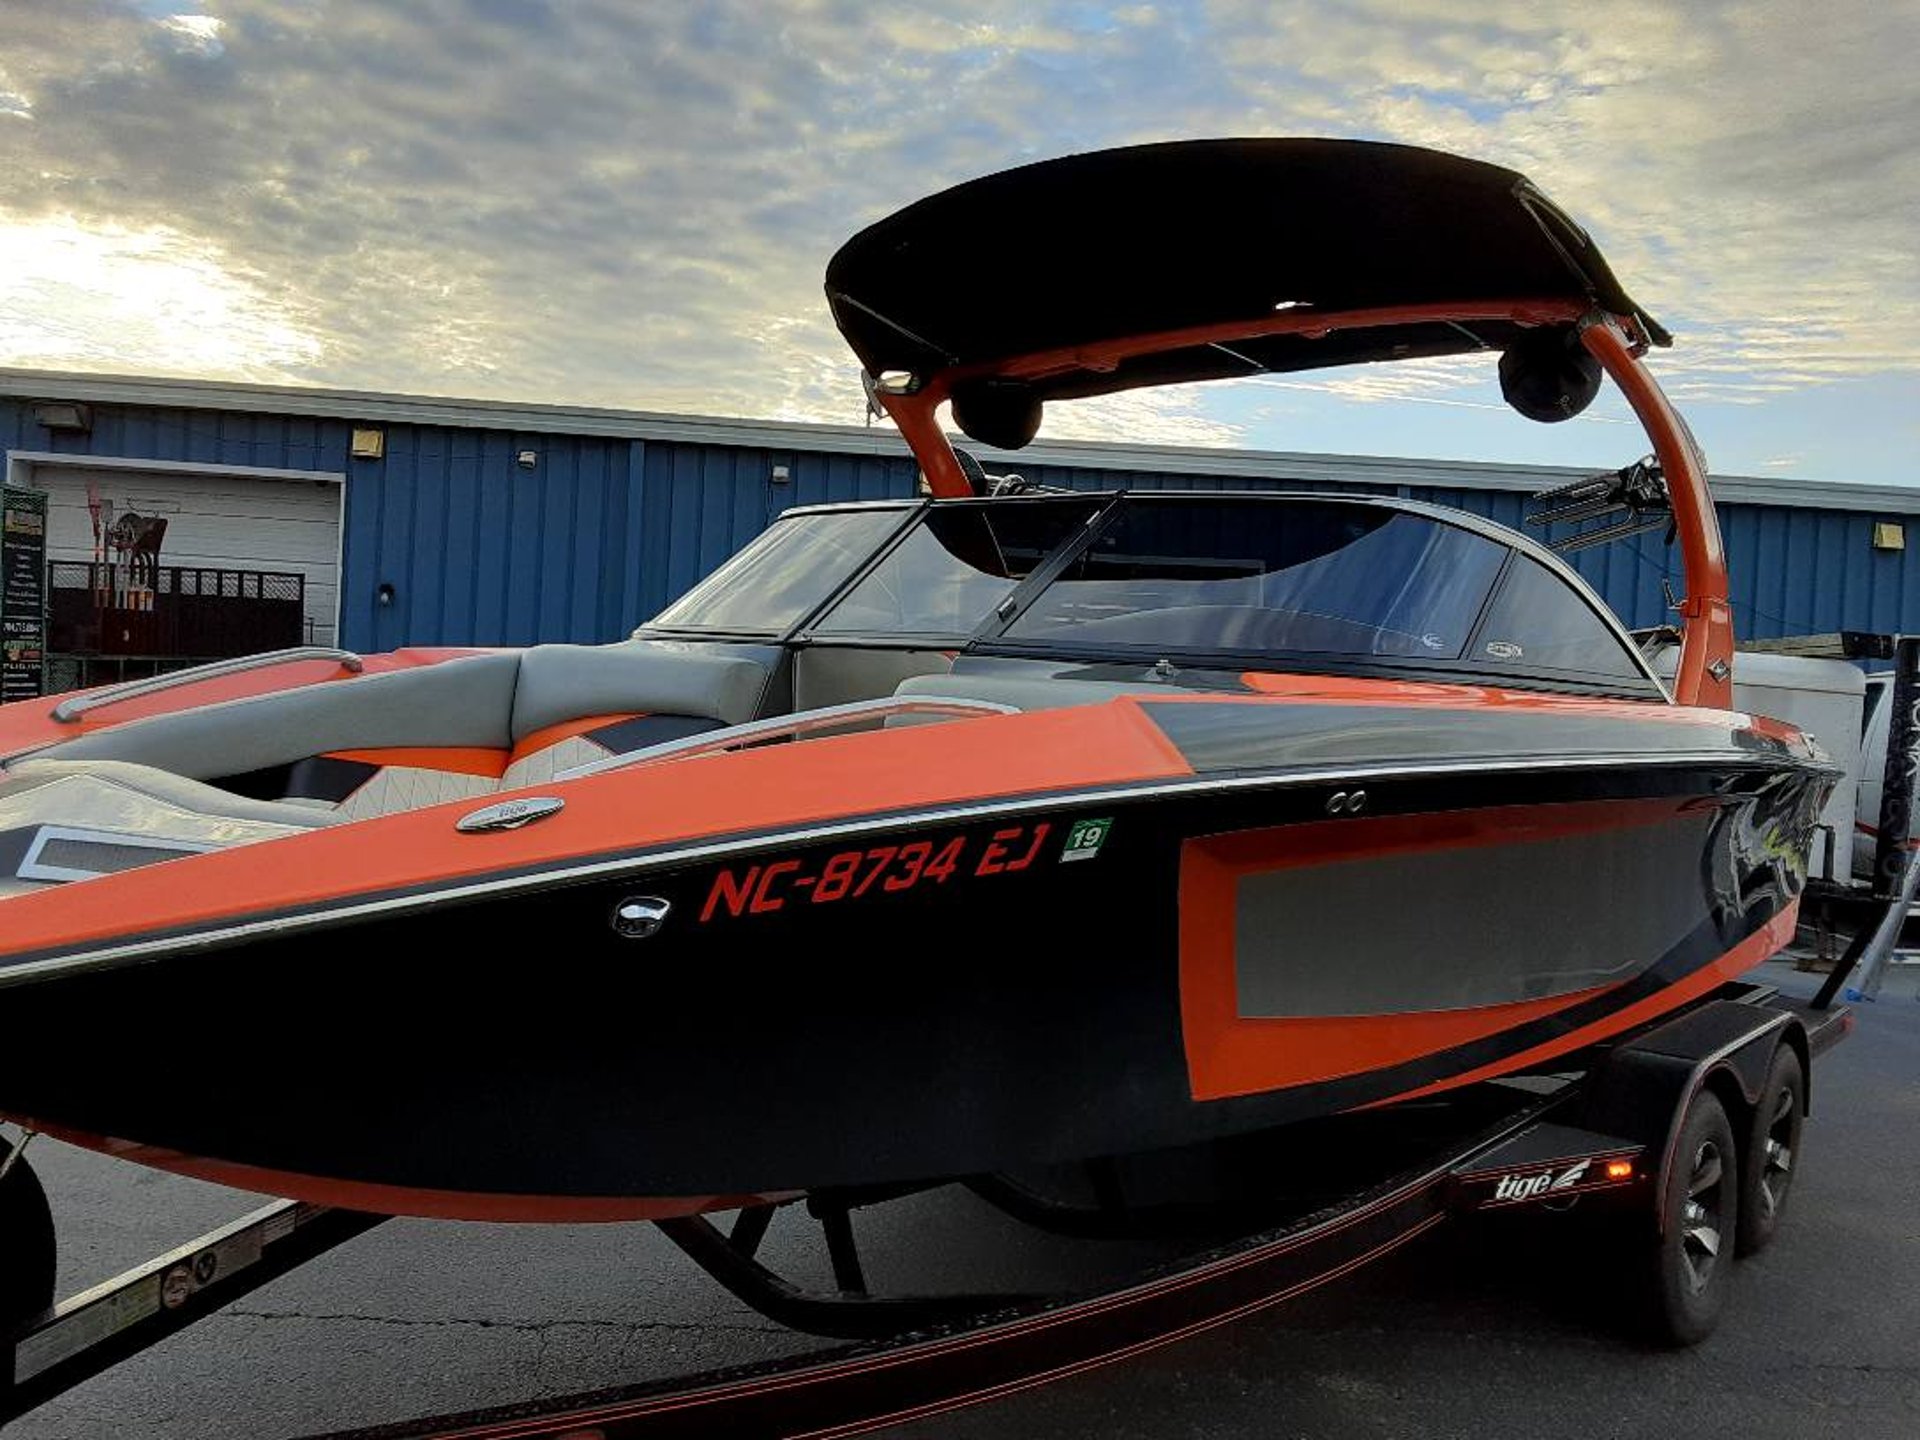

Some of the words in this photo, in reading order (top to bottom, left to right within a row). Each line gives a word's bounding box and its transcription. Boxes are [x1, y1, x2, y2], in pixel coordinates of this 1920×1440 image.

[1073, 827, 1101, 847] 19
[700, 836, 966, 921] NC-8734
[974, 823, 1051, 876] EJ
